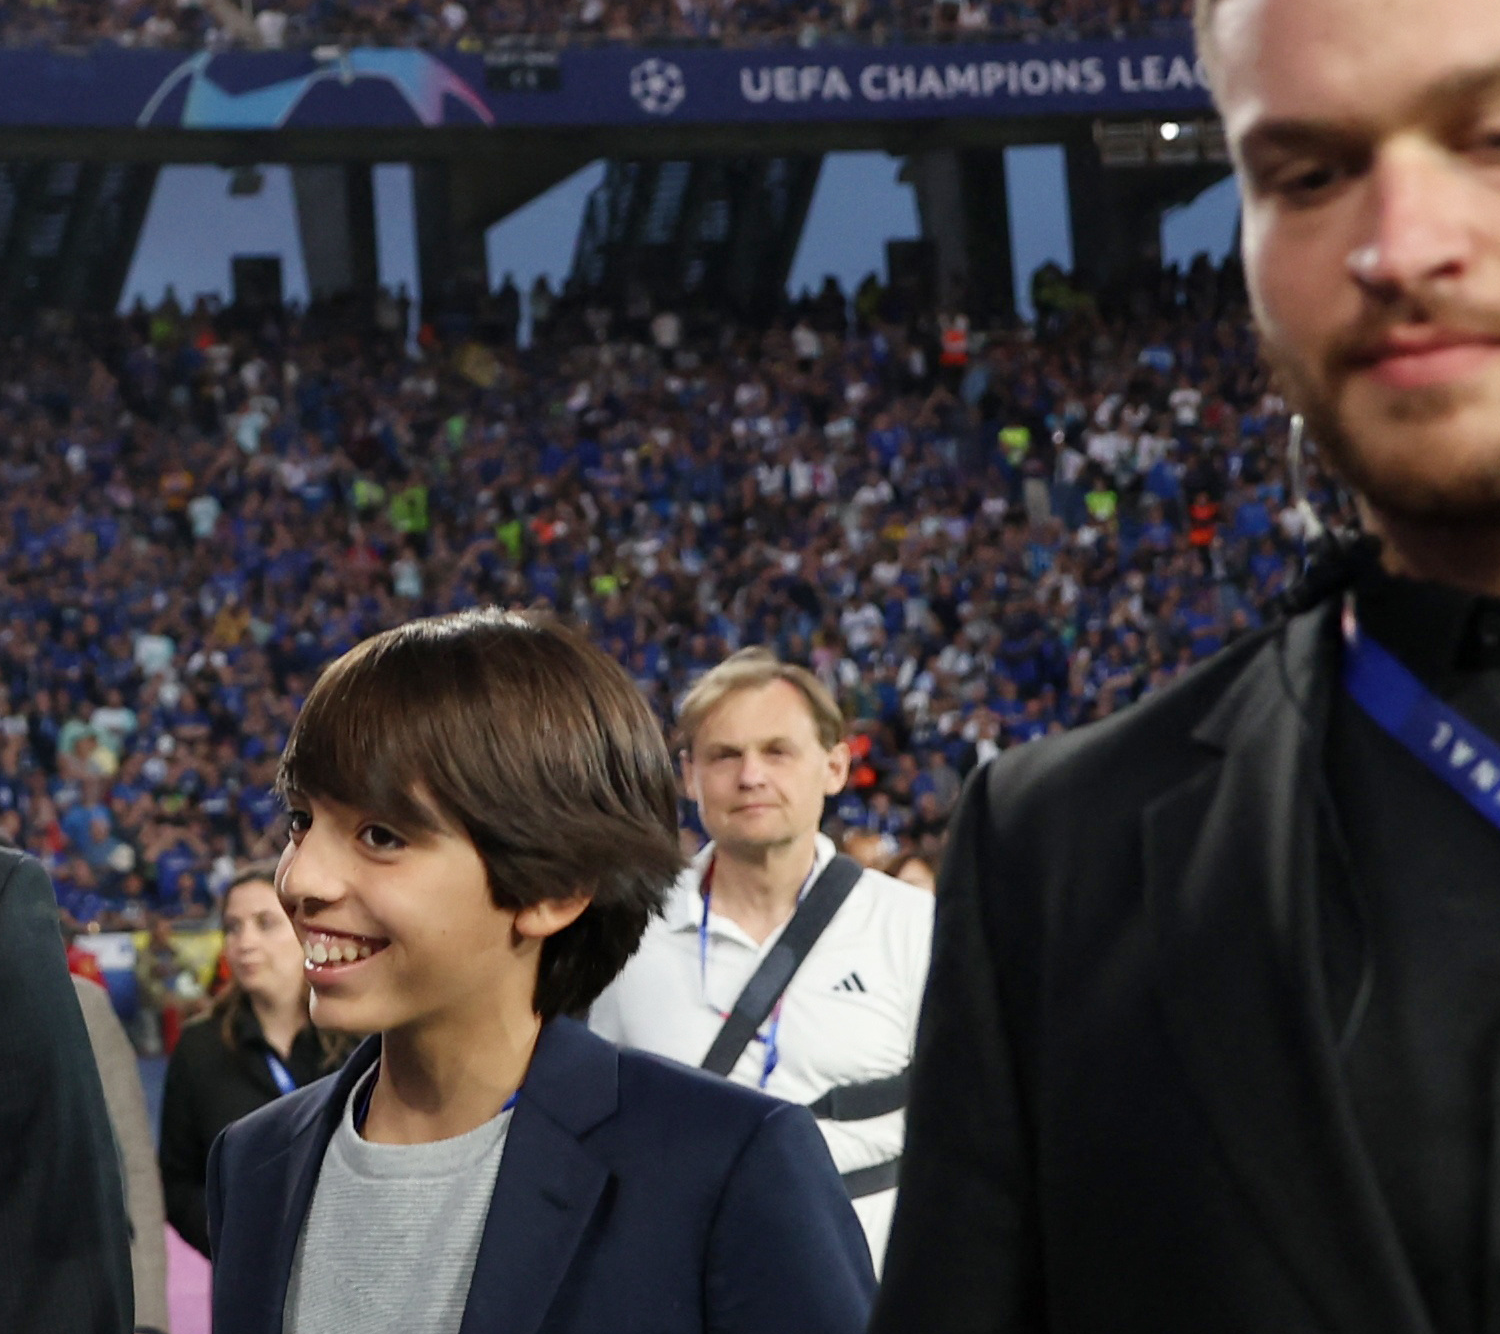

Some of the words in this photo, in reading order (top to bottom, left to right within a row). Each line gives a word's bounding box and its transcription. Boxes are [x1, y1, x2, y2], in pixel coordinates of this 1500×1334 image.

[740, 65, 853, 103] UEFA
[859, 57, 1105, 101] CHAMPIONS
[1118, 54, 1211, 93] LEA
